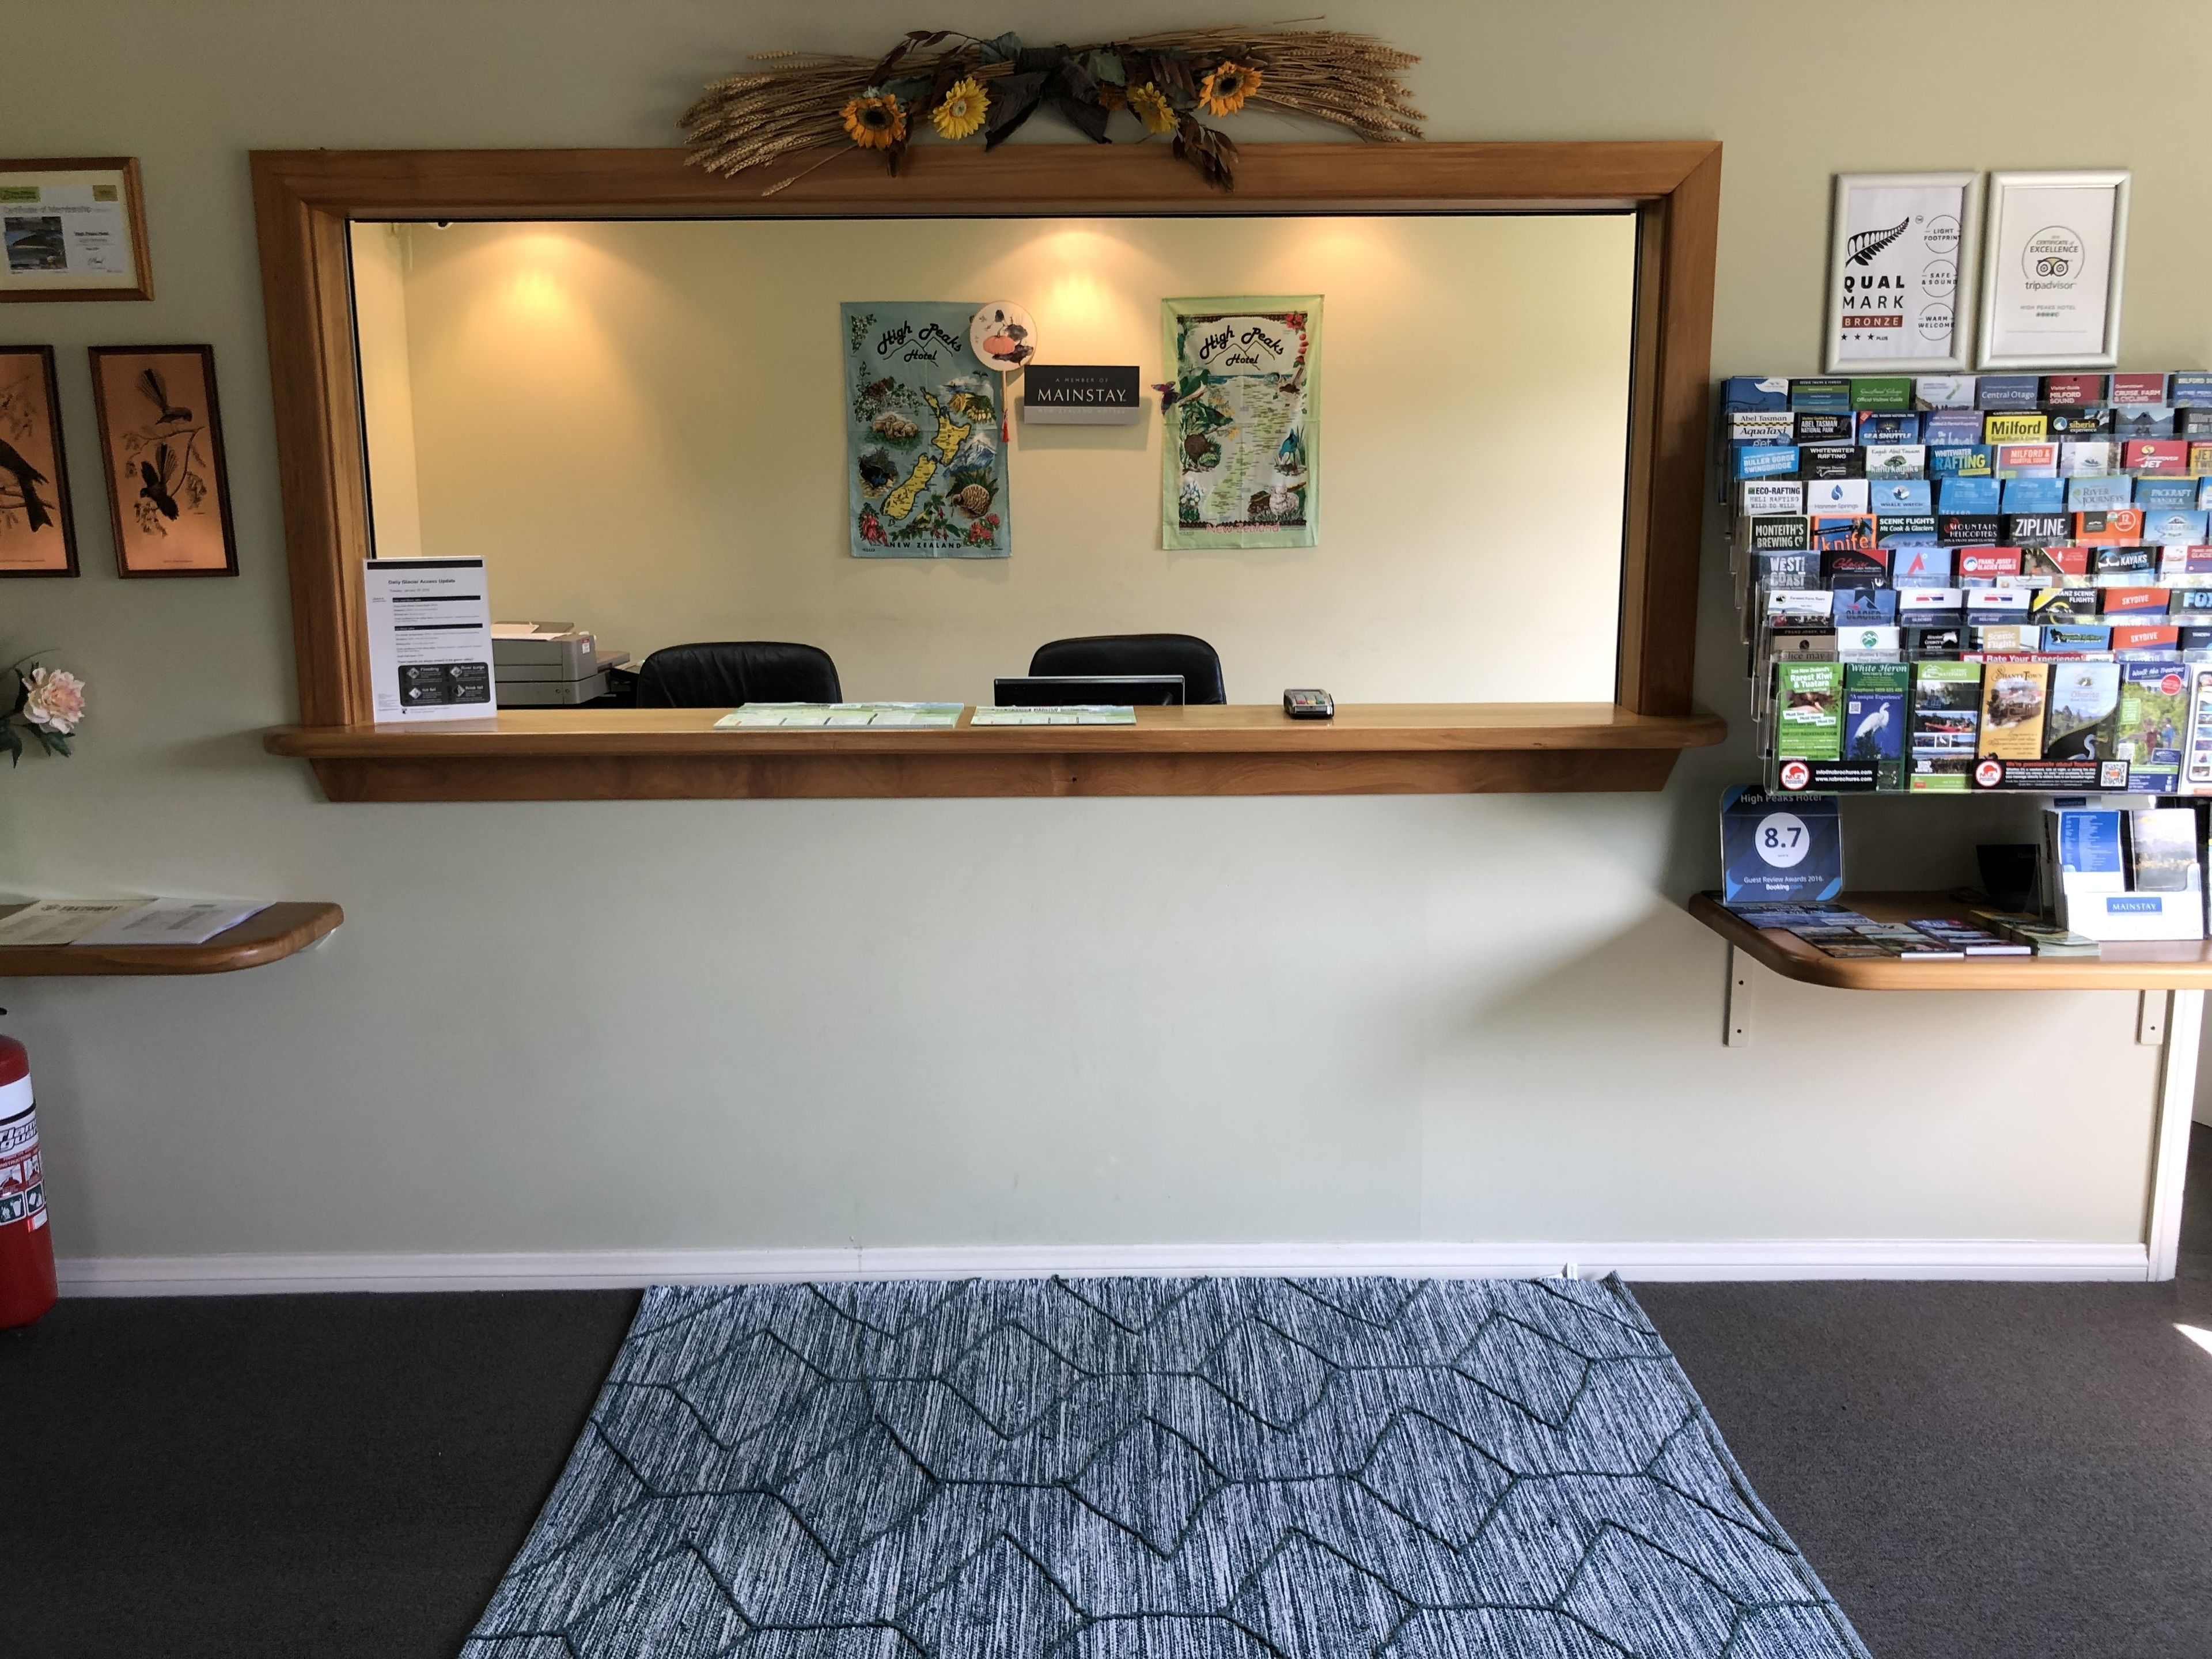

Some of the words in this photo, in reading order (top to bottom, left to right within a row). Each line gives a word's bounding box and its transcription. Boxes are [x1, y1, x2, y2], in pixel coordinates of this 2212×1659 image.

[1844, 275, 1905, 293] QUAL
[2025, 281, 2074, 291] tripadvisor
[1843, 296, 1904, 309] MARK
[1844, 317, 1899, 326] BRONZE
[877, 320, 913, 355] High
[918, 323, 962, 352] Peaks
[1199, 325, 1234, 359] High
[1241, 327, 1284, 355] Peaks
[903, 349, 938, 363] Hotel
[1225, 354, 1260, 366] Hotel
[1037, 389, 1126, 402] MAINSTAY
[1982, 391, 2009, 399] Central
[2011, 391, 2035, 400] Otago
[1991, 421, 2041, 434] Milford
[2069, 421, 2095, 429] siberia
[1934, 448, 1972, 457] WHITEWATER
[2010, 449, 2043, 457] MILFORD
[1743, 457, 1770, 467] BULLER
[1771, 454, 1795, 463] GORGE
[1935, 454, 1985, 471] RAFTING
[1744, 461, 1792, 474] SWINGBRIDGE
[2151, 489, 2192, 497] PACKRAFT
[2082, 495, 2124, 507] JOURNEYS
[1205, 523, 1233, 534] New
[1236, 522, 1280, 533] Zealand
[1755, 524, 1804, 536] MONTEITH'S
[2015, 518, 2066, 537] ZIPLINE
[1757, 536, 1793, 548] BREWING
[2120, 554, 2148, 566] KAYAKS
[1770, 572, 1806, 586] COAST
[2122, 594, 2149, 605] SKYDIVE
[1846, 610, 1881, 620] GLACIER
[1987, 632, 2015, 641] Scenic
[2130, 632, 2158, 643] SKYDIVE
[1987, 641, 2016, 649] Flights
[1987, 654, 2011, 662] Rate
[2012, 654, 2030, 662] Your
[1851, 664, 1877, 672] White
[1878, 664, 1907, 673] Heron
[1740, 794, 1763, 805] High
[1764, 827, 1802, 848] 8.7
